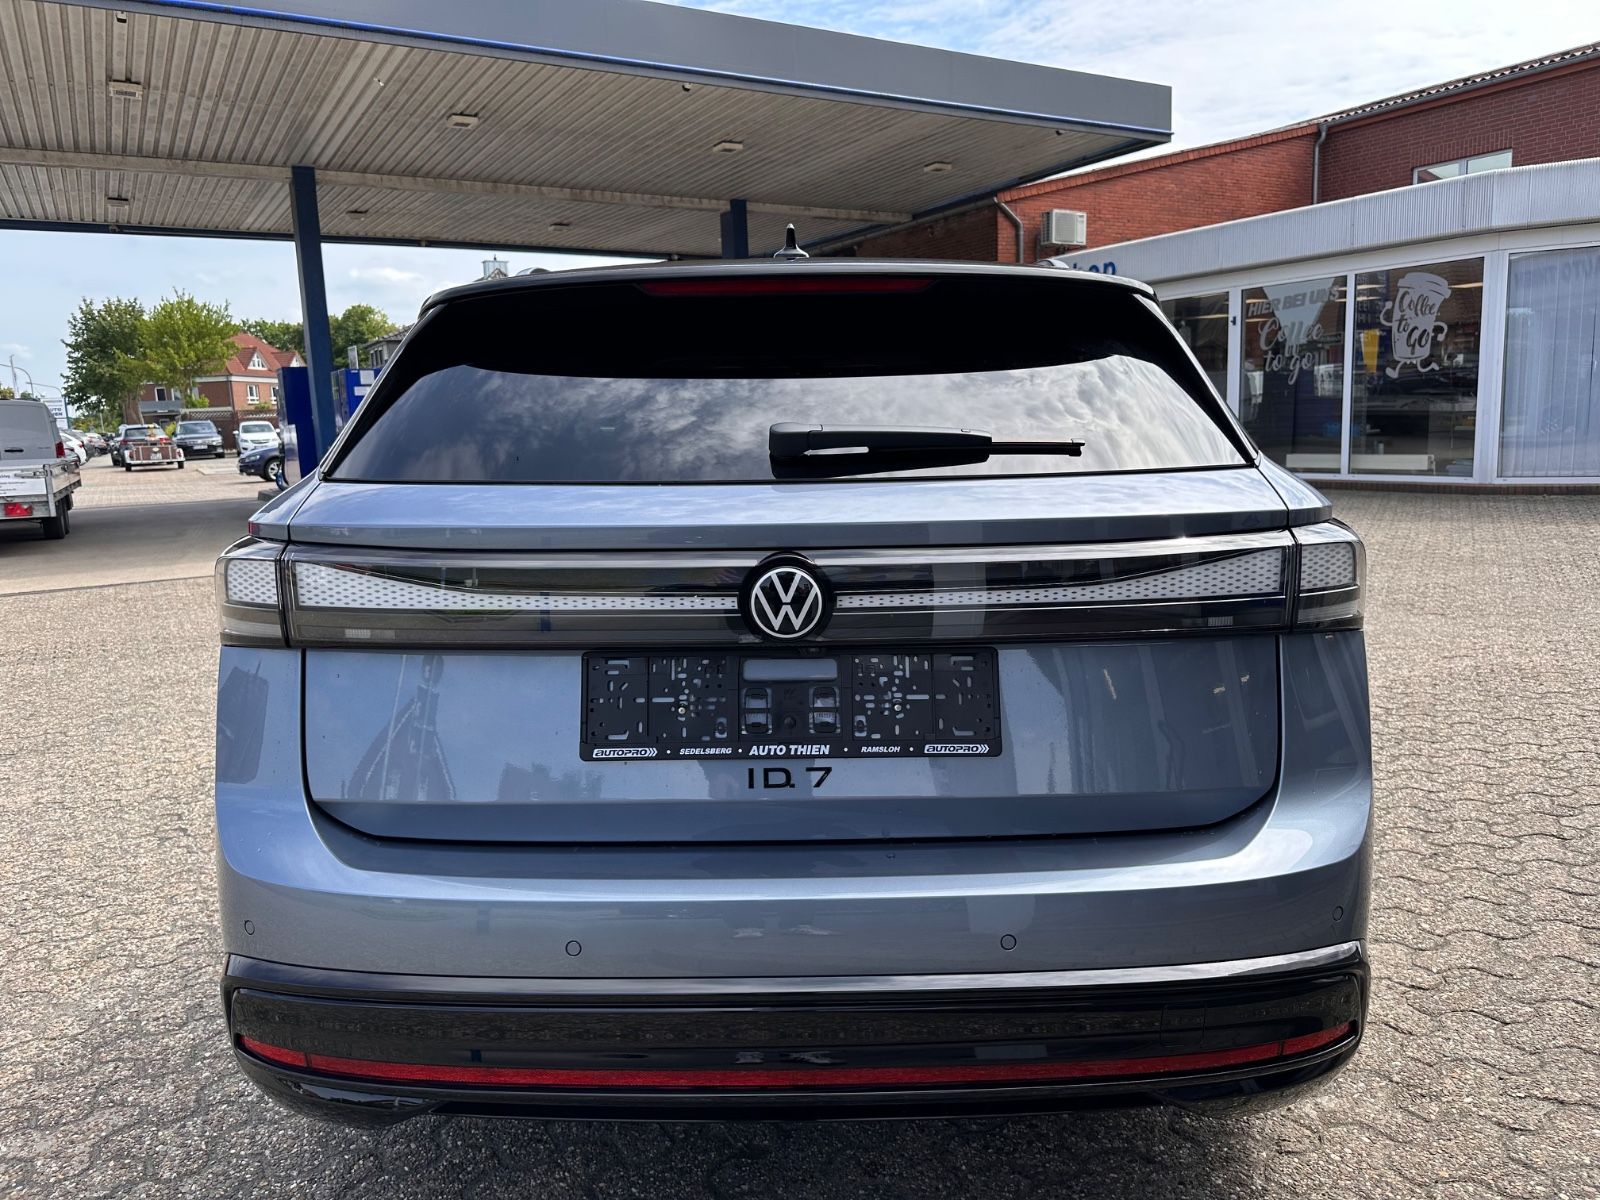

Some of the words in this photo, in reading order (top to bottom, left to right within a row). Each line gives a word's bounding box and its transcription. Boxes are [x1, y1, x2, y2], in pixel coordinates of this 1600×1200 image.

[1247, 297, 1281, 317] HIER
[1282, 292, 1306, 310] BEI
[1309, 286, 1339, 305] UNS
[1398, 290, 1436, 317] Coffee
[1258, 317, 1322, 357] Coffee
[1394, 314, 1410, 334] to
[1263, 351, 1282, 372] to
[1288, 352, 1315, 385] go
[679, 747, 733, 755] SEDELSBERG
[749, 744, 786, 756] AUTO
[787, 744, 831, 755] THIEN
